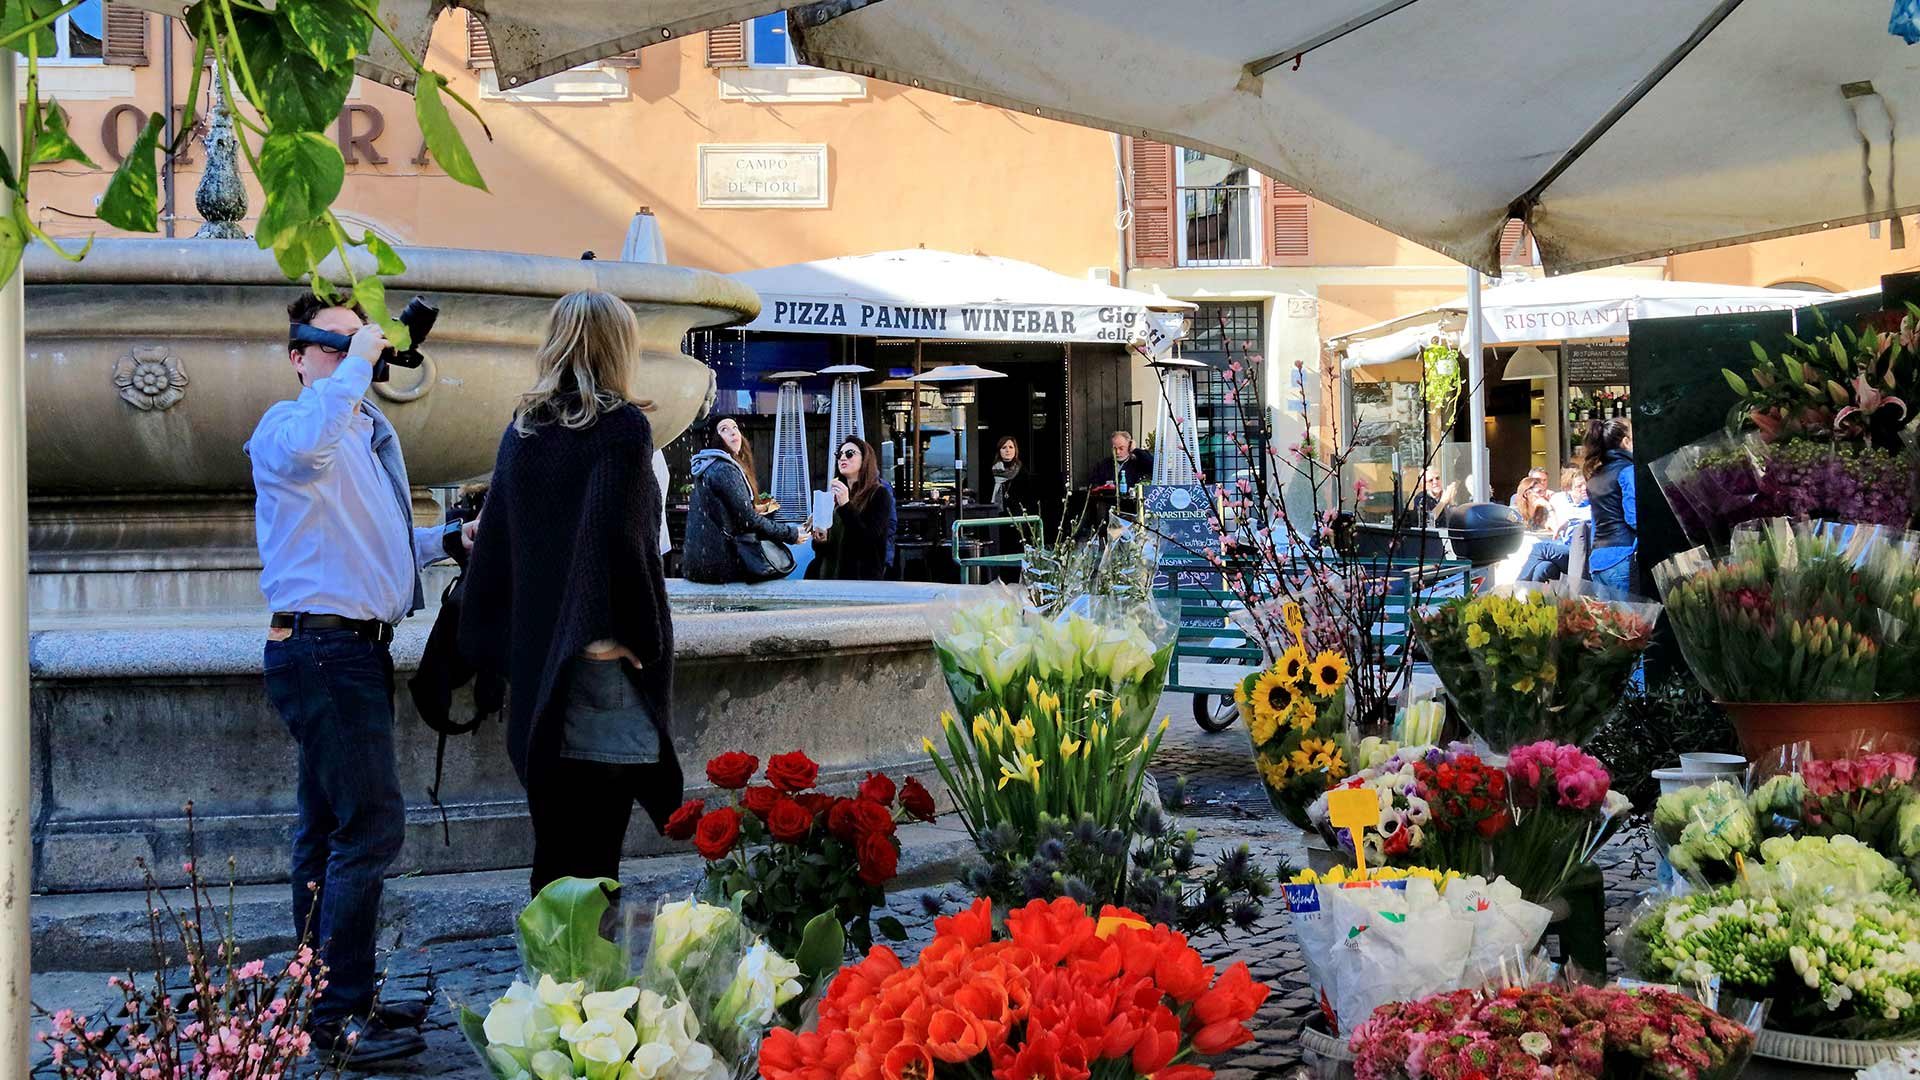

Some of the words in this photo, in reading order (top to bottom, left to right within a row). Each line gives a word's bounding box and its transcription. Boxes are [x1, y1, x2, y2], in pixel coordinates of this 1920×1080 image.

[736, 159, 788, 170] CAMPO
[755, 181, 797, 193] FIORI
[774, 301, 847, 327] PIZZA
[860, 304, 947, 330] PANINI
[961, 308, 1077, 334] WINEBAR
[1503, 307, 1634, 330] RISTORANTE
[1154, 510, 1207, 520] WARSTEINER
